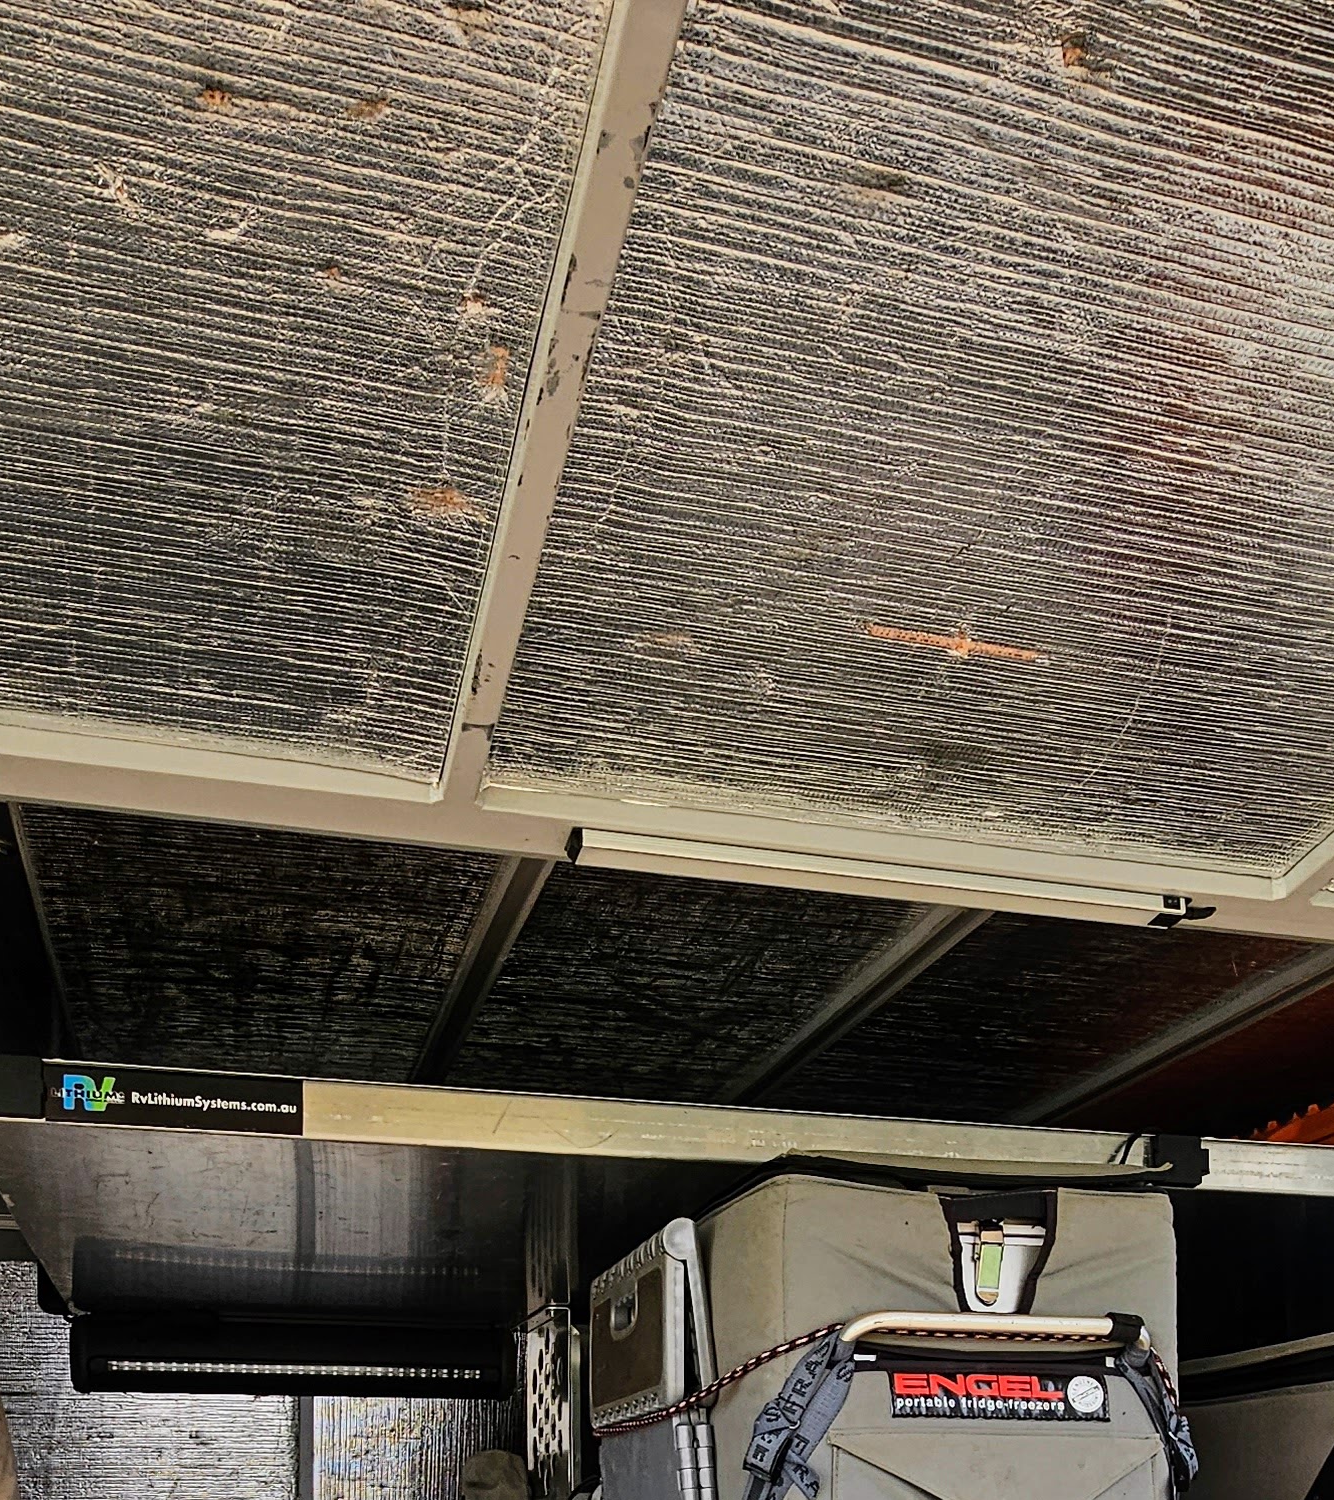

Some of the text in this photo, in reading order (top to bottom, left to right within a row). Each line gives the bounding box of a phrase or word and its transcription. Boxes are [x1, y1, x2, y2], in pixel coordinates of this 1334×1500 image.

[131, 1091, 298, 1114] RvLithiumSystems.com.au
[893, 1373, 1065, 1400] ENGEL
[895, 1396, 956, 1410] portable
[961, 1397, 1065, 1412] fridge-freezers
